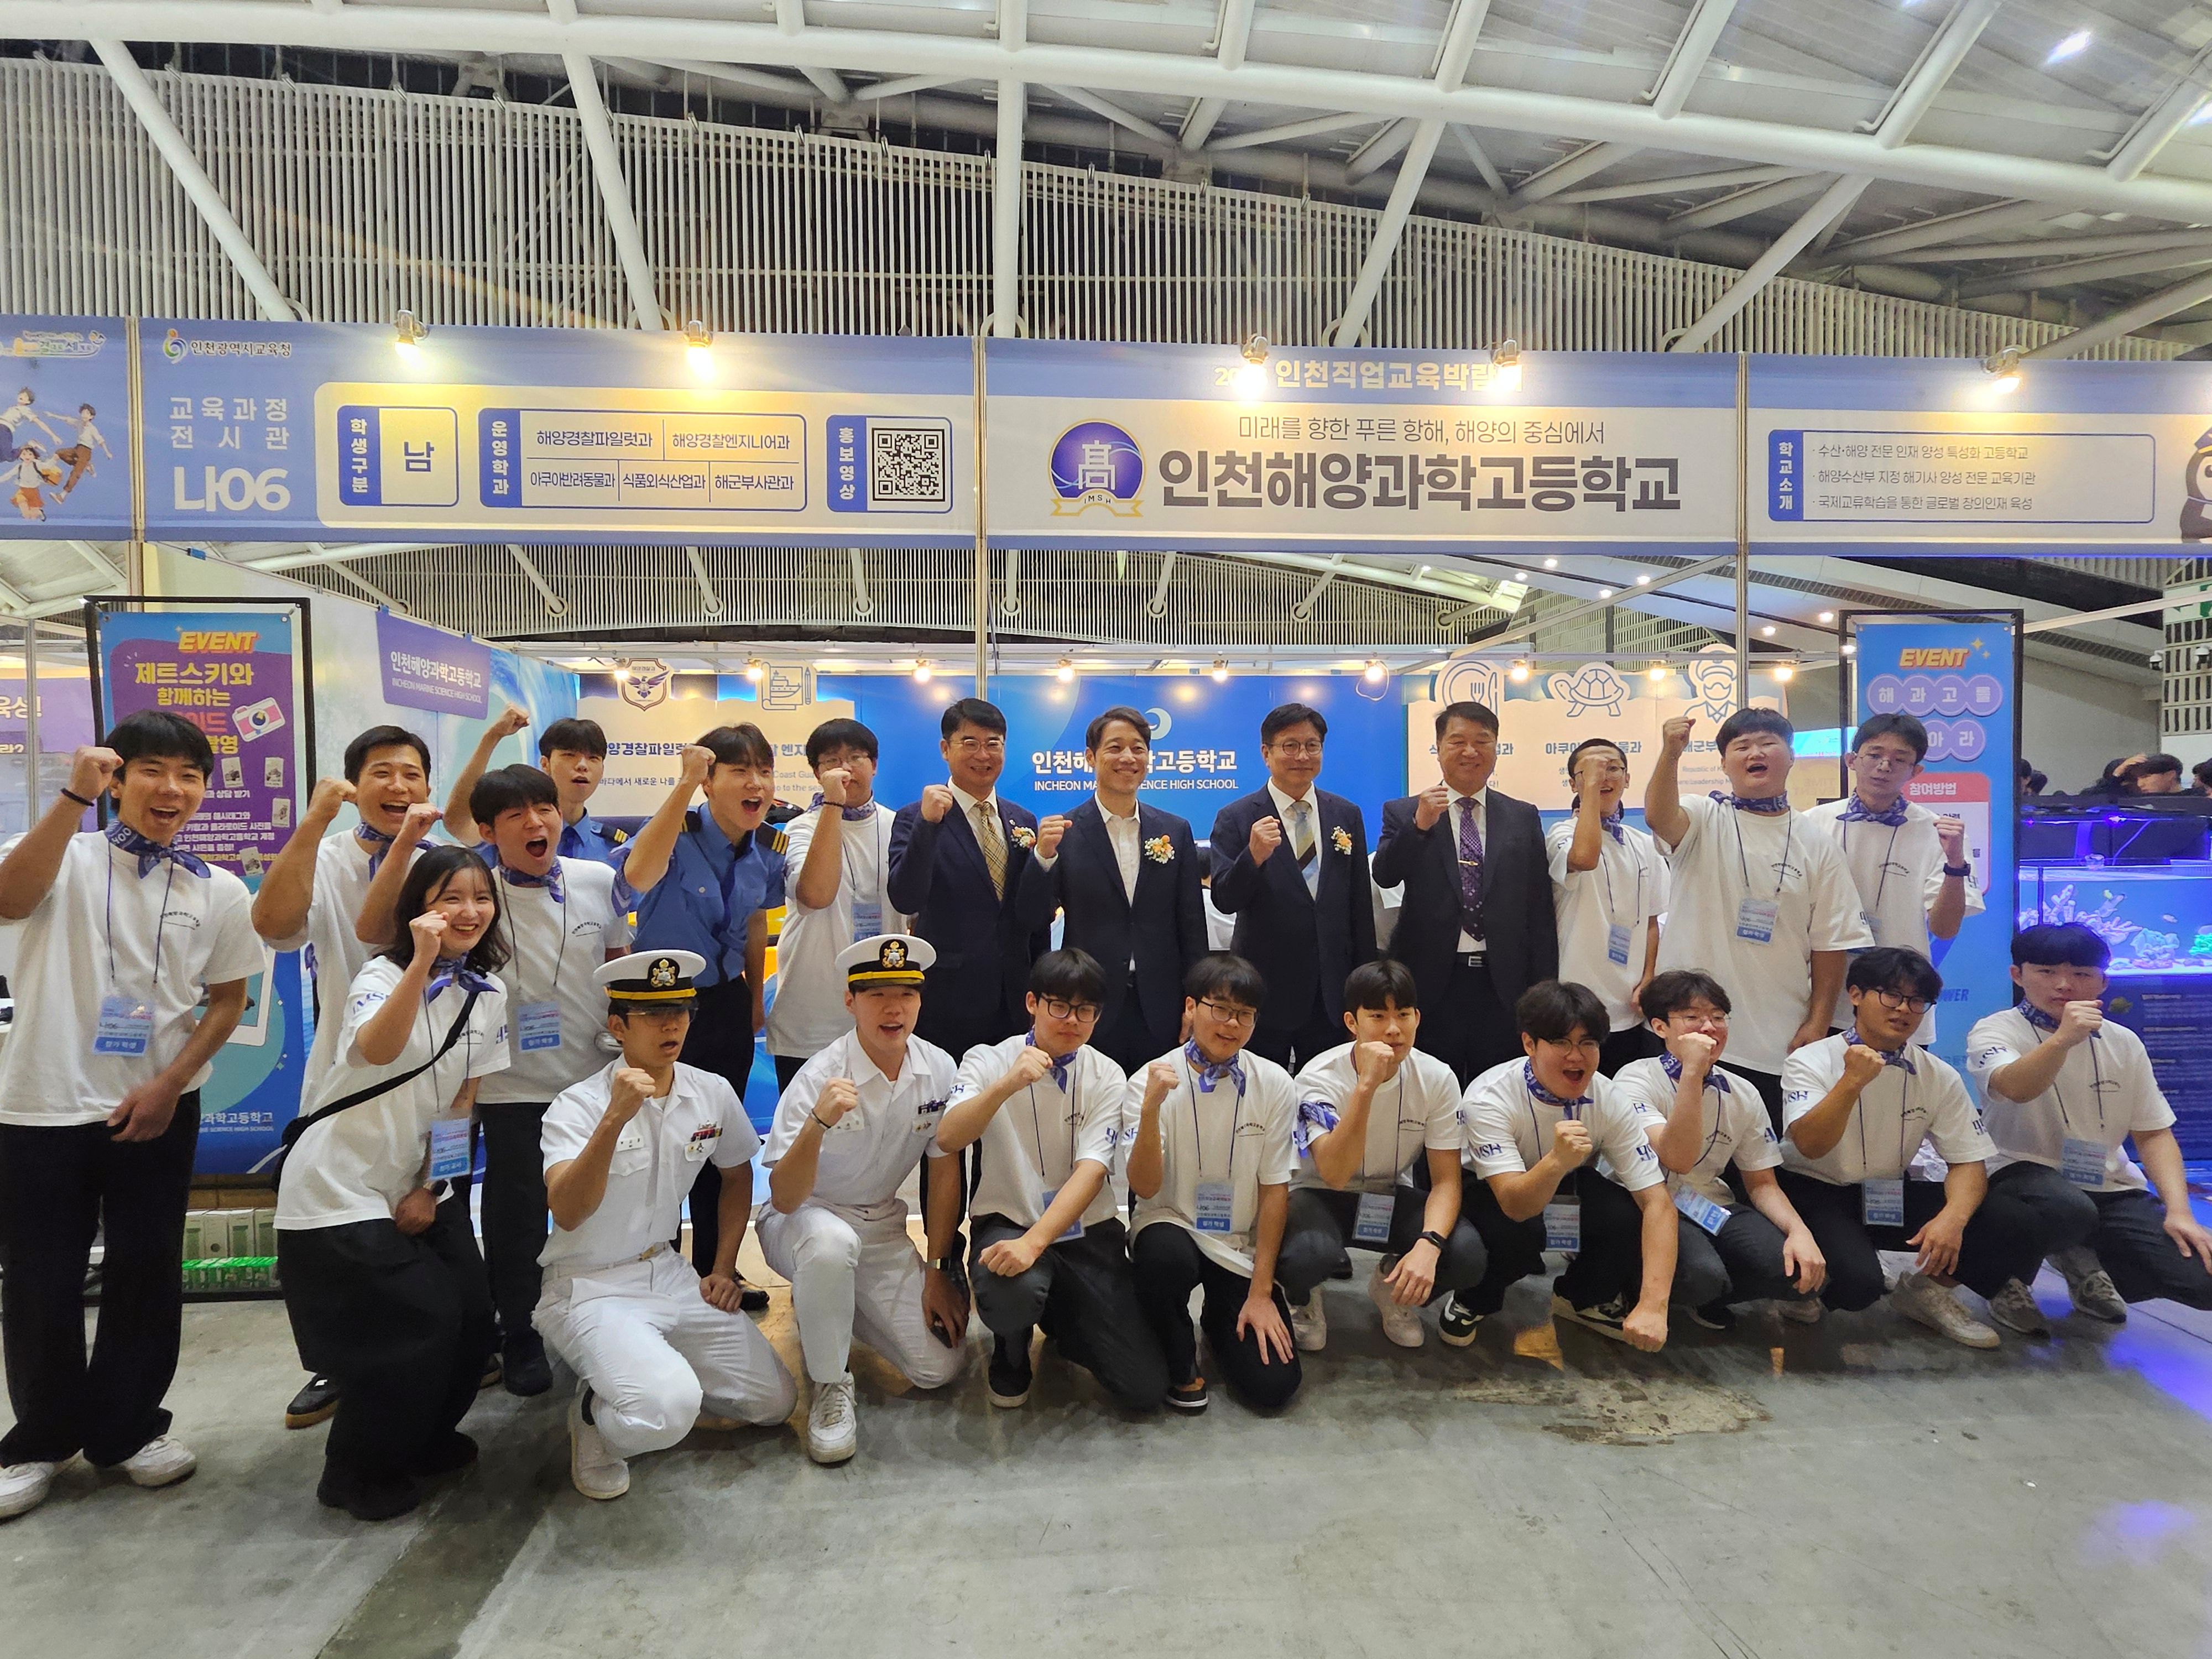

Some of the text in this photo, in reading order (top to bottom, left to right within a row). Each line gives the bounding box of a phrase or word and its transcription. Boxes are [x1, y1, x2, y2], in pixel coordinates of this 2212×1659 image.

[191, 339, 291, 358] 인천광역시교육청
[170, 396, 288, 421] 교육과정
[169, 425, 289, 451] 전시관
[536, 428, 654, 449] 해양경찰파일럿과
[671, 431, 791, 451] 해양경찰엔지니어과
[1238, 415, 1606, 446] 미래를 향한 푸른 항해, 해양의 중심에서
[350, 417, 368, 494] 학생구분
[403, 440, 435, 473] 남
[491, 419, 509, 496] 운영학과
[839, 426, 855, 500] 홍보영상
[1871, 445, 1893, 458] 전문
[1896, 445, 1918, 458] 인재
[1922, 445, 1944, 459] 양성
[1947, 446, 1981, 460] 특성화
[1983, 446, 2028, 460] 고등학교
[530, 469, 616, 489] 아쿠아반려동물과
[622, 471, 706, 491] 식품외식산업과
[714, 474, 794, 493] 해군부사관과
[1158, 448, 1683, 513] 인천해양과학고등학교
[1778, 441, 1793, 510] 학교소개
[1818, 469, 2036, 486] 해양수산부 지정 해기사 양성 전문 교육기관
[1818, 495, 2032, 510] 국제교류학습을 통한 글로벌 창의인재 육성
[178, 631, 260, 655] EVENT
[390, 650, 482, 688] 인천해양과학고등학교
[1899, 648, 1971, 669] EVENT
[135, 662, 255, 686] 제트스키와
[156, 687, 231, 707] 함께하는
[634, 776, 657, 786] 새로운
[660, 776, 675, 786] 나를
[1034, 780, 1081, 791] INCHEON
[1170, 779, 1195, 790] HIGH
[1196, 779, 1239, 790] SCHOOL
[1910, 782, 1957, 796] 참여방법
